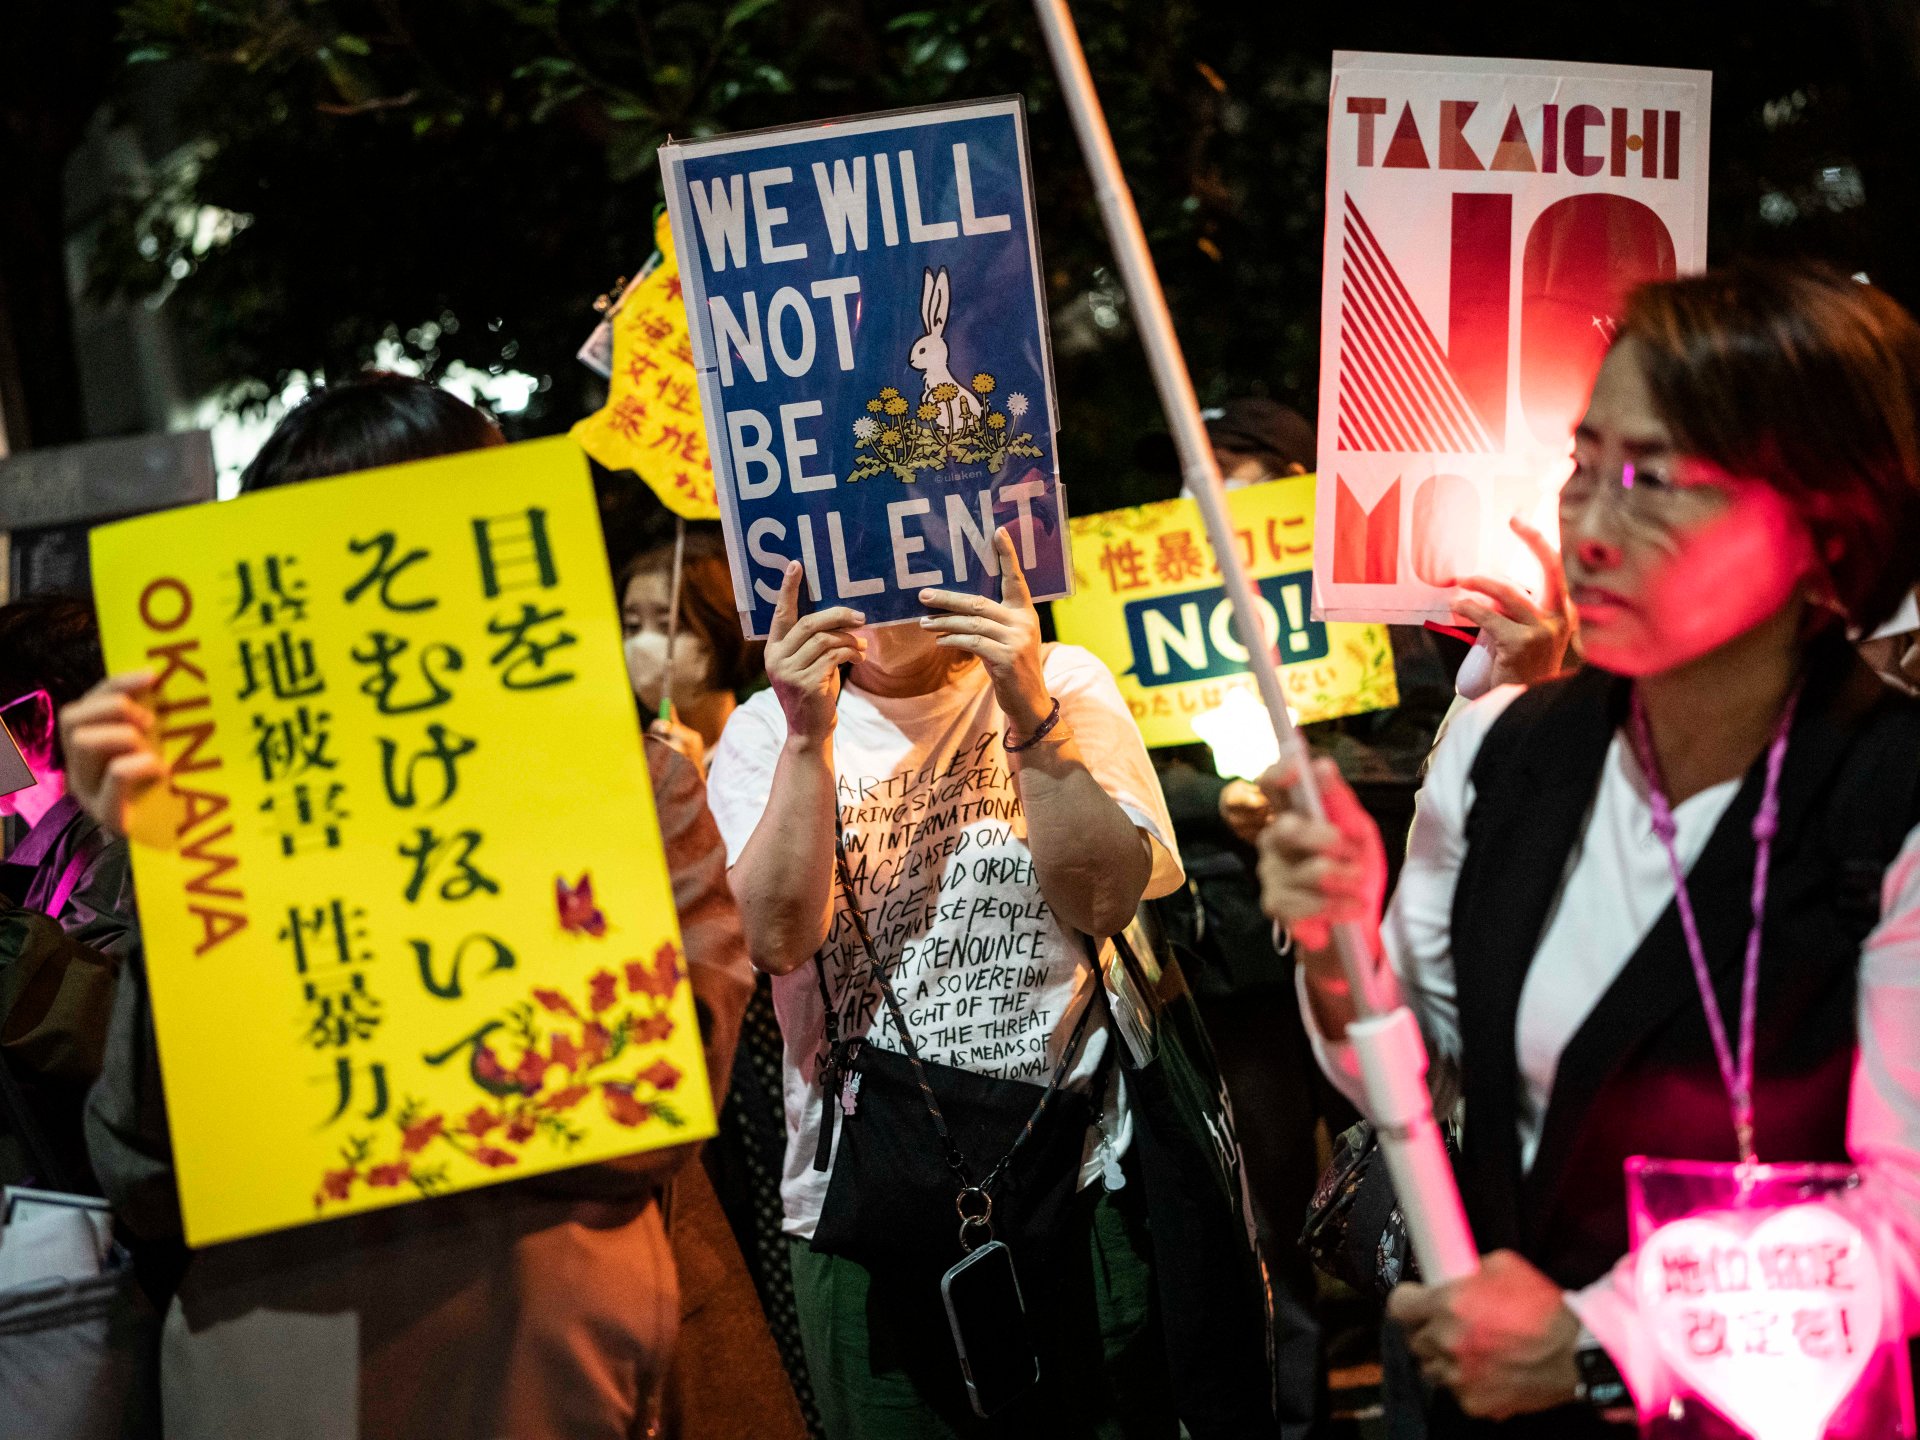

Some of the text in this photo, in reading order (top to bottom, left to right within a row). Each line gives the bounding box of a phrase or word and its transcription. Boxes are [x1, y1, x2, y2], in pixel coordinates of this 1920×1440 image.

[1346, 97, 1681, 180] TAKAICHI
[689, 142, 1012, 272] WE WILL
[708, 276, 862, 387] NOT
[726, 400, 837, 501] BE
[746, 480, 1045, 607] SILENT
[1333, 472, 1482, 587] MO
[470, 506, 578, 690] 目を
[1142, 583, 1310, 676] NO!
[137, 576, 249, 957] OKINAWA
[838, 731, 998, 801] ARTICLE 9.
[912, 766, 1015, 811] SINCERELY
[219, 554, 390, 1131] 基地被害 性暴力
[844, 797, 1026, 853] AN INTERNATIONA
[909, 831, 970, 879] BASED
[976, 825, 1012, 849] ON
[822, 940, 868, 970] THE
[967, 896, 1050, 932] PEOPLE
[916, 930, 1047, 975] RENOUNCE
[882, 992, 1030, 1036] RGHT OF THE
[917, 980, 929, 1000] A
[930, 1025, 973, 1047] THE
[978, 1010, 1050, 1039] THREAT
[950, 1050, 967, 1067] AS
[971, 1040, 1025, 1063] MEANS
[1030, 1033, 1052, 1052] OF
